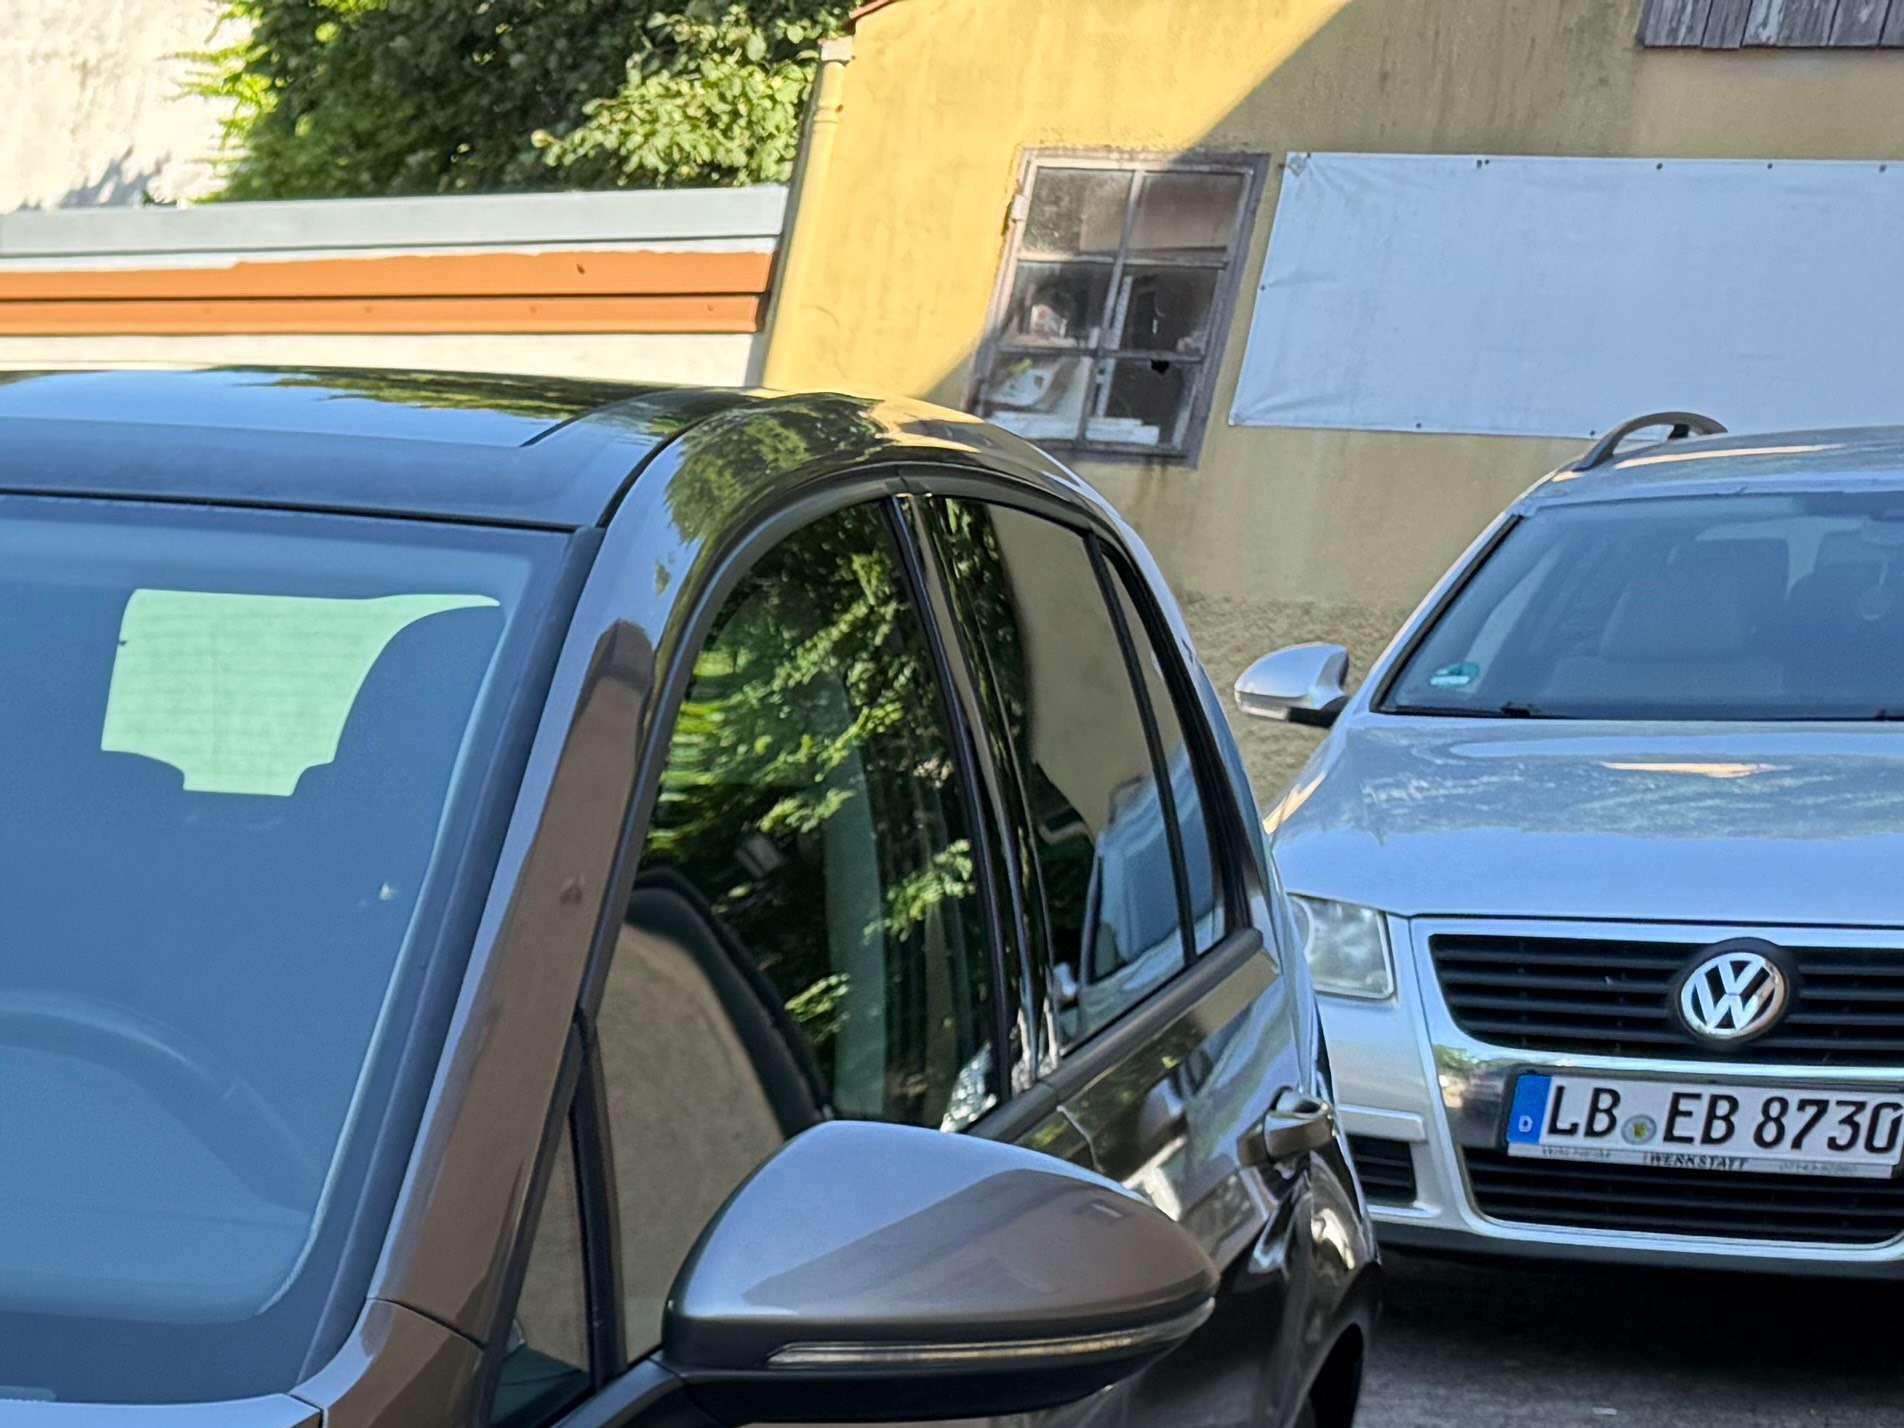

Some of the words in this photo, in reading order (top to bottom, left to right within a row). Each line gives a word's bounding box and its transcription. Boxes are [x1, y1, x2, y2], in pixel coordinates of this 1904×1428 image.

[1682, 952, 1789, 1038] VW
[1518, 1115, 1533, 1133] D
[1547, 1085, 1621, 1138] LB
[1663, 1091, 1740, 1146] EB
[1753, 1096, 1903, 1154] 8730
